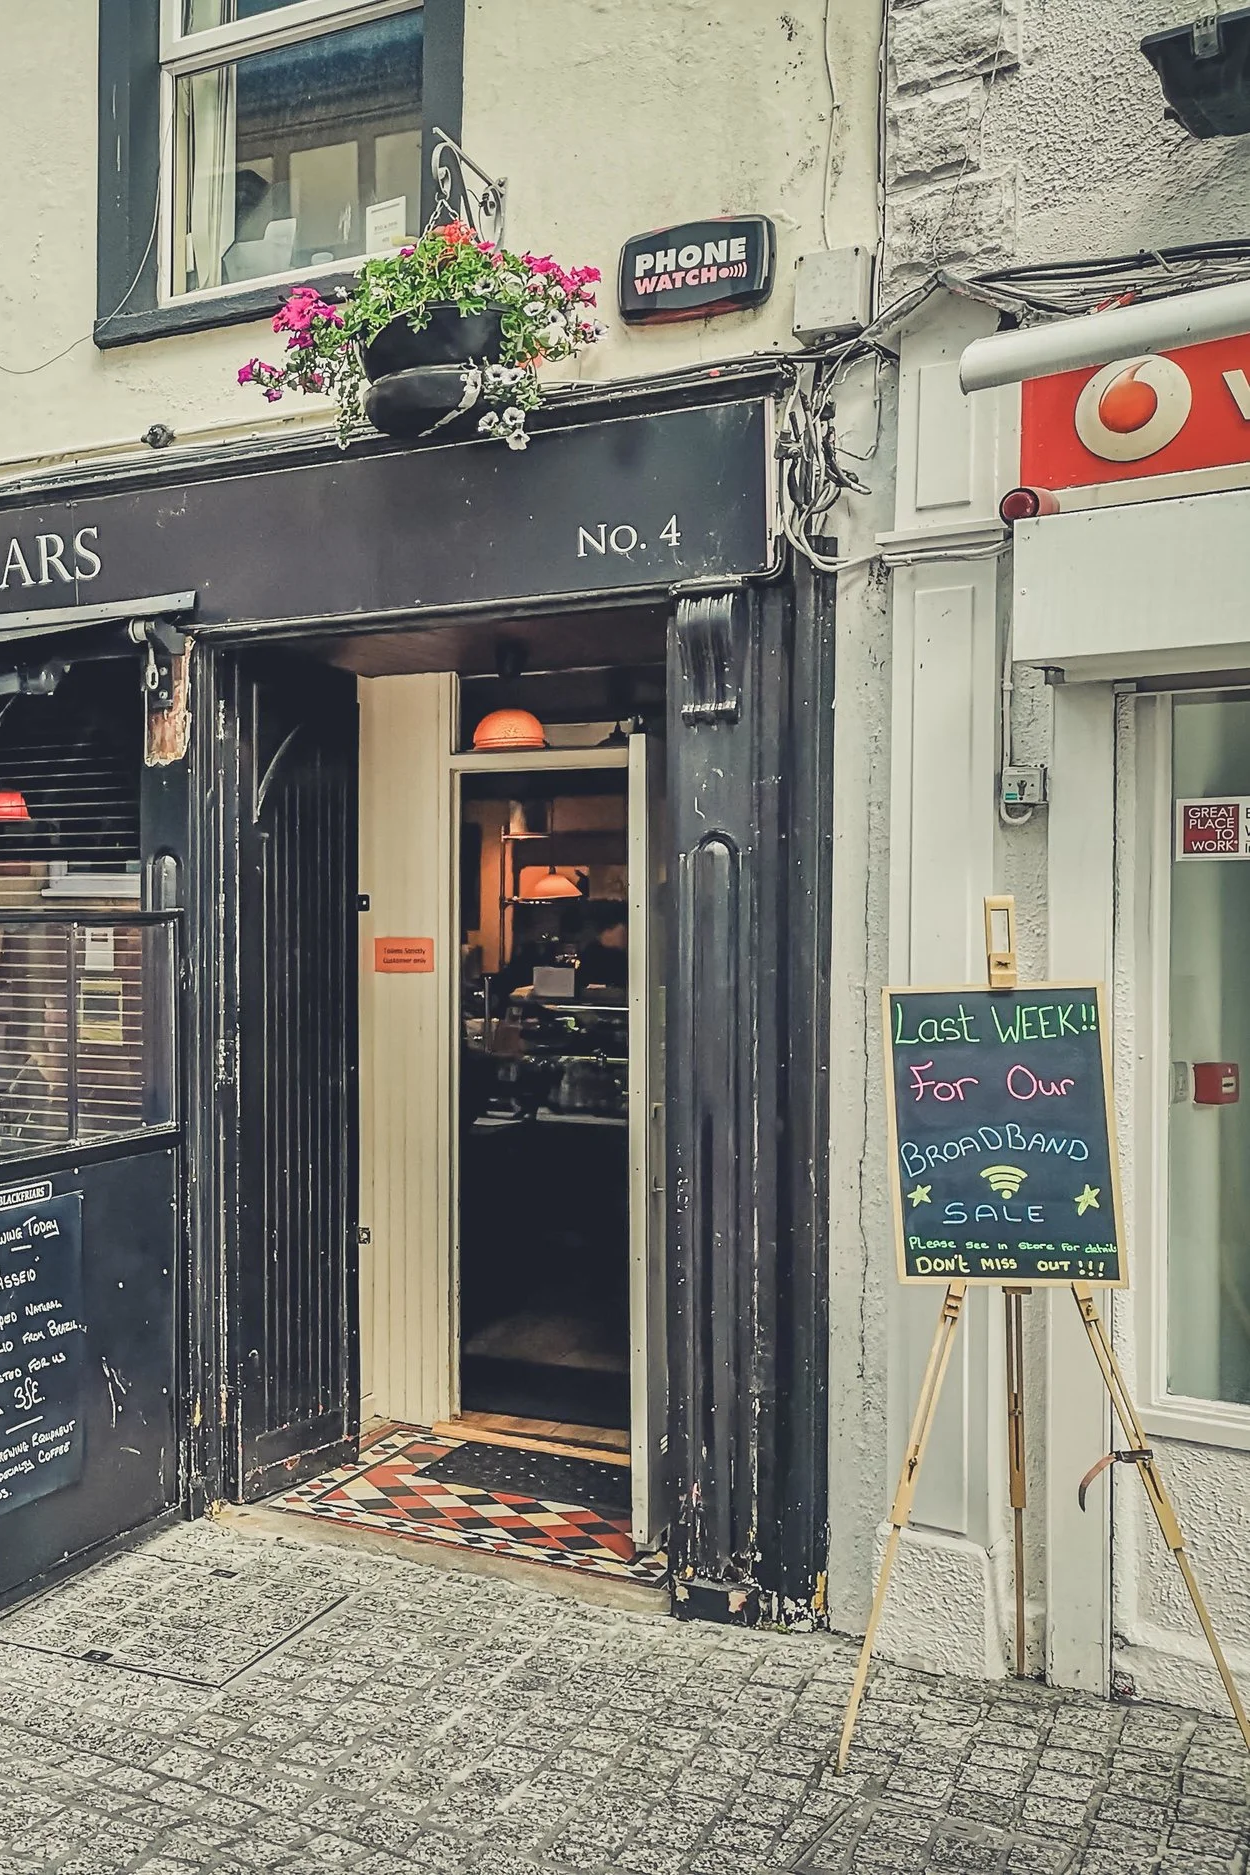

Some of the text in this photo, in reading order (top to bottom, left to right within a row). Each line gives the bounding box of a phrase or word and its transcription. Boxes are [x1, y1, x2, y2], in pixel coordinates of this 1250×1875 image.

[635, 237, 747, 278] PHONE
[634, 266, 718, 296] WATCH
[660, 514, 682, 548] 4
[1188, 806, 1235, 818] GREAT
[1189, 817, 1235, 830] PLACE
[1215, 829, 1235, 840] TO
[991, 1003, 1098, 1044] WEEK!!
[1006, 1064, 1075, 1100] Our
[900, 1123, 1090, 1179] BROADBAND
[942, 1202, 1045, 1224] SALE
[980, 1258, 1018, 1271] MISS
[28, 1357, 50, 1373] FOR
[38, 1441, 71, 1463] COFFEE
